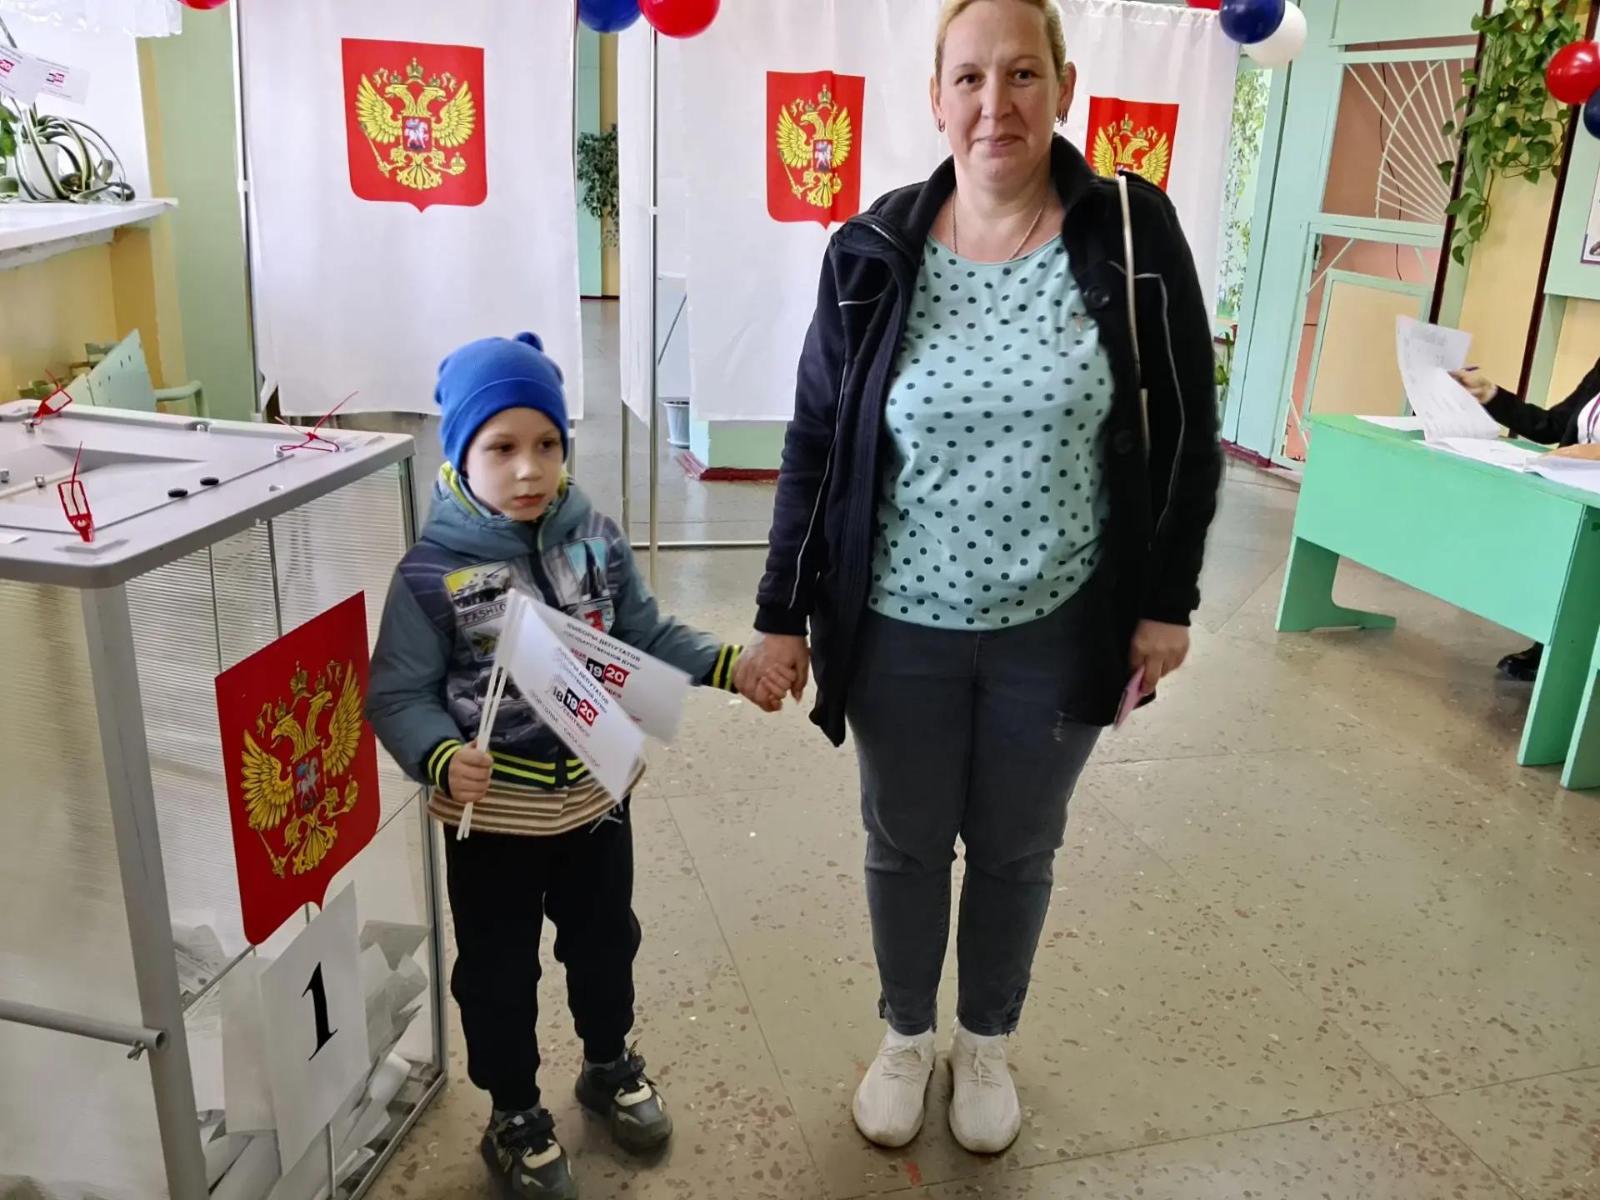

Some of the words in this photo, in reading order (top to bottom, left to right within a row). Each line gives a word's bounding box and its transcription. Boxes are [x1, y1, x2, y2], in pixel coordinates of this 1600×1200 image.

[463, 603, 506, 623] FASHIO
[599, 639, 641, 662] ДЕПУТАТОВ
[587, 664, 603, 678] 19
[605, 667, 624, 682] 20
[553, 687, 563, 702] 18
[567, 694, 578, 711] 19
[580, 702, 596, 721] 20
[302, 961, 338, 1061] 1
